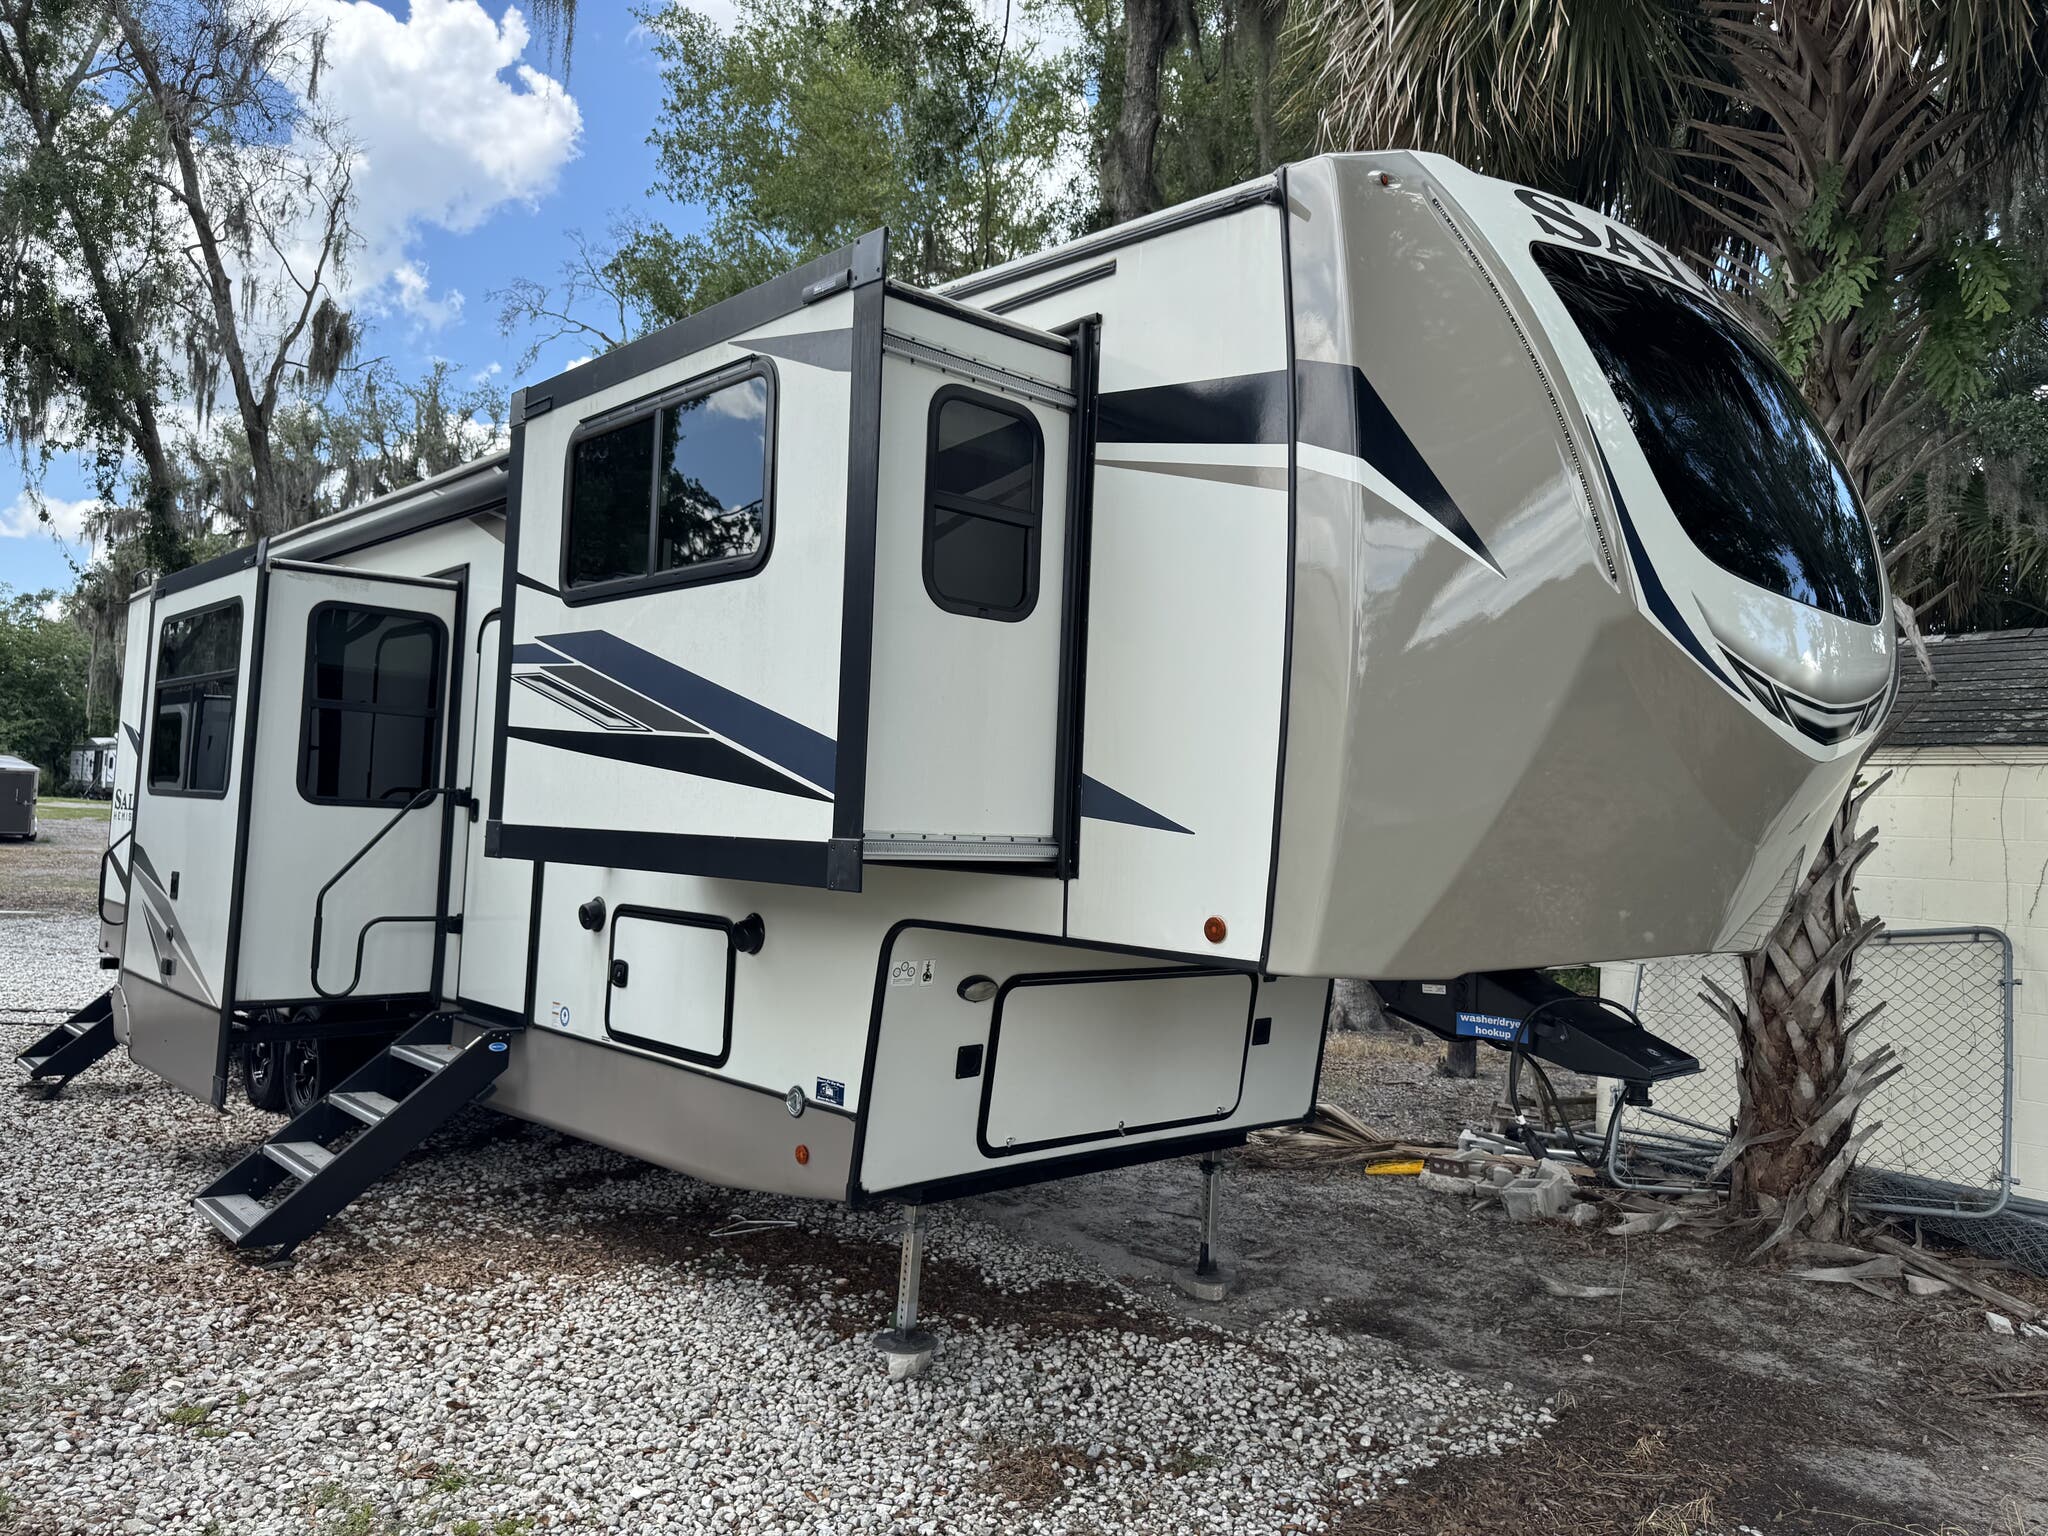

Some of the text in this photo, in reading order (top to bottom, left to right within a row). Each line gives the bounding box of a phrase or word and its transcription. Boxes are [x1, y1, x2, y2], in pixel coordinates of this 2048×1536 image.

[1514, 189, 1719, 303] SAL
[1577, 254, 1678, 303] HEM
[114, 788, 134, 811] SAL
[113, 811, 132, 821] HEMIS
[1460, 1014, 1521, 1029] washer/drye
[1475, 1026, 1511, 1040] hookup
